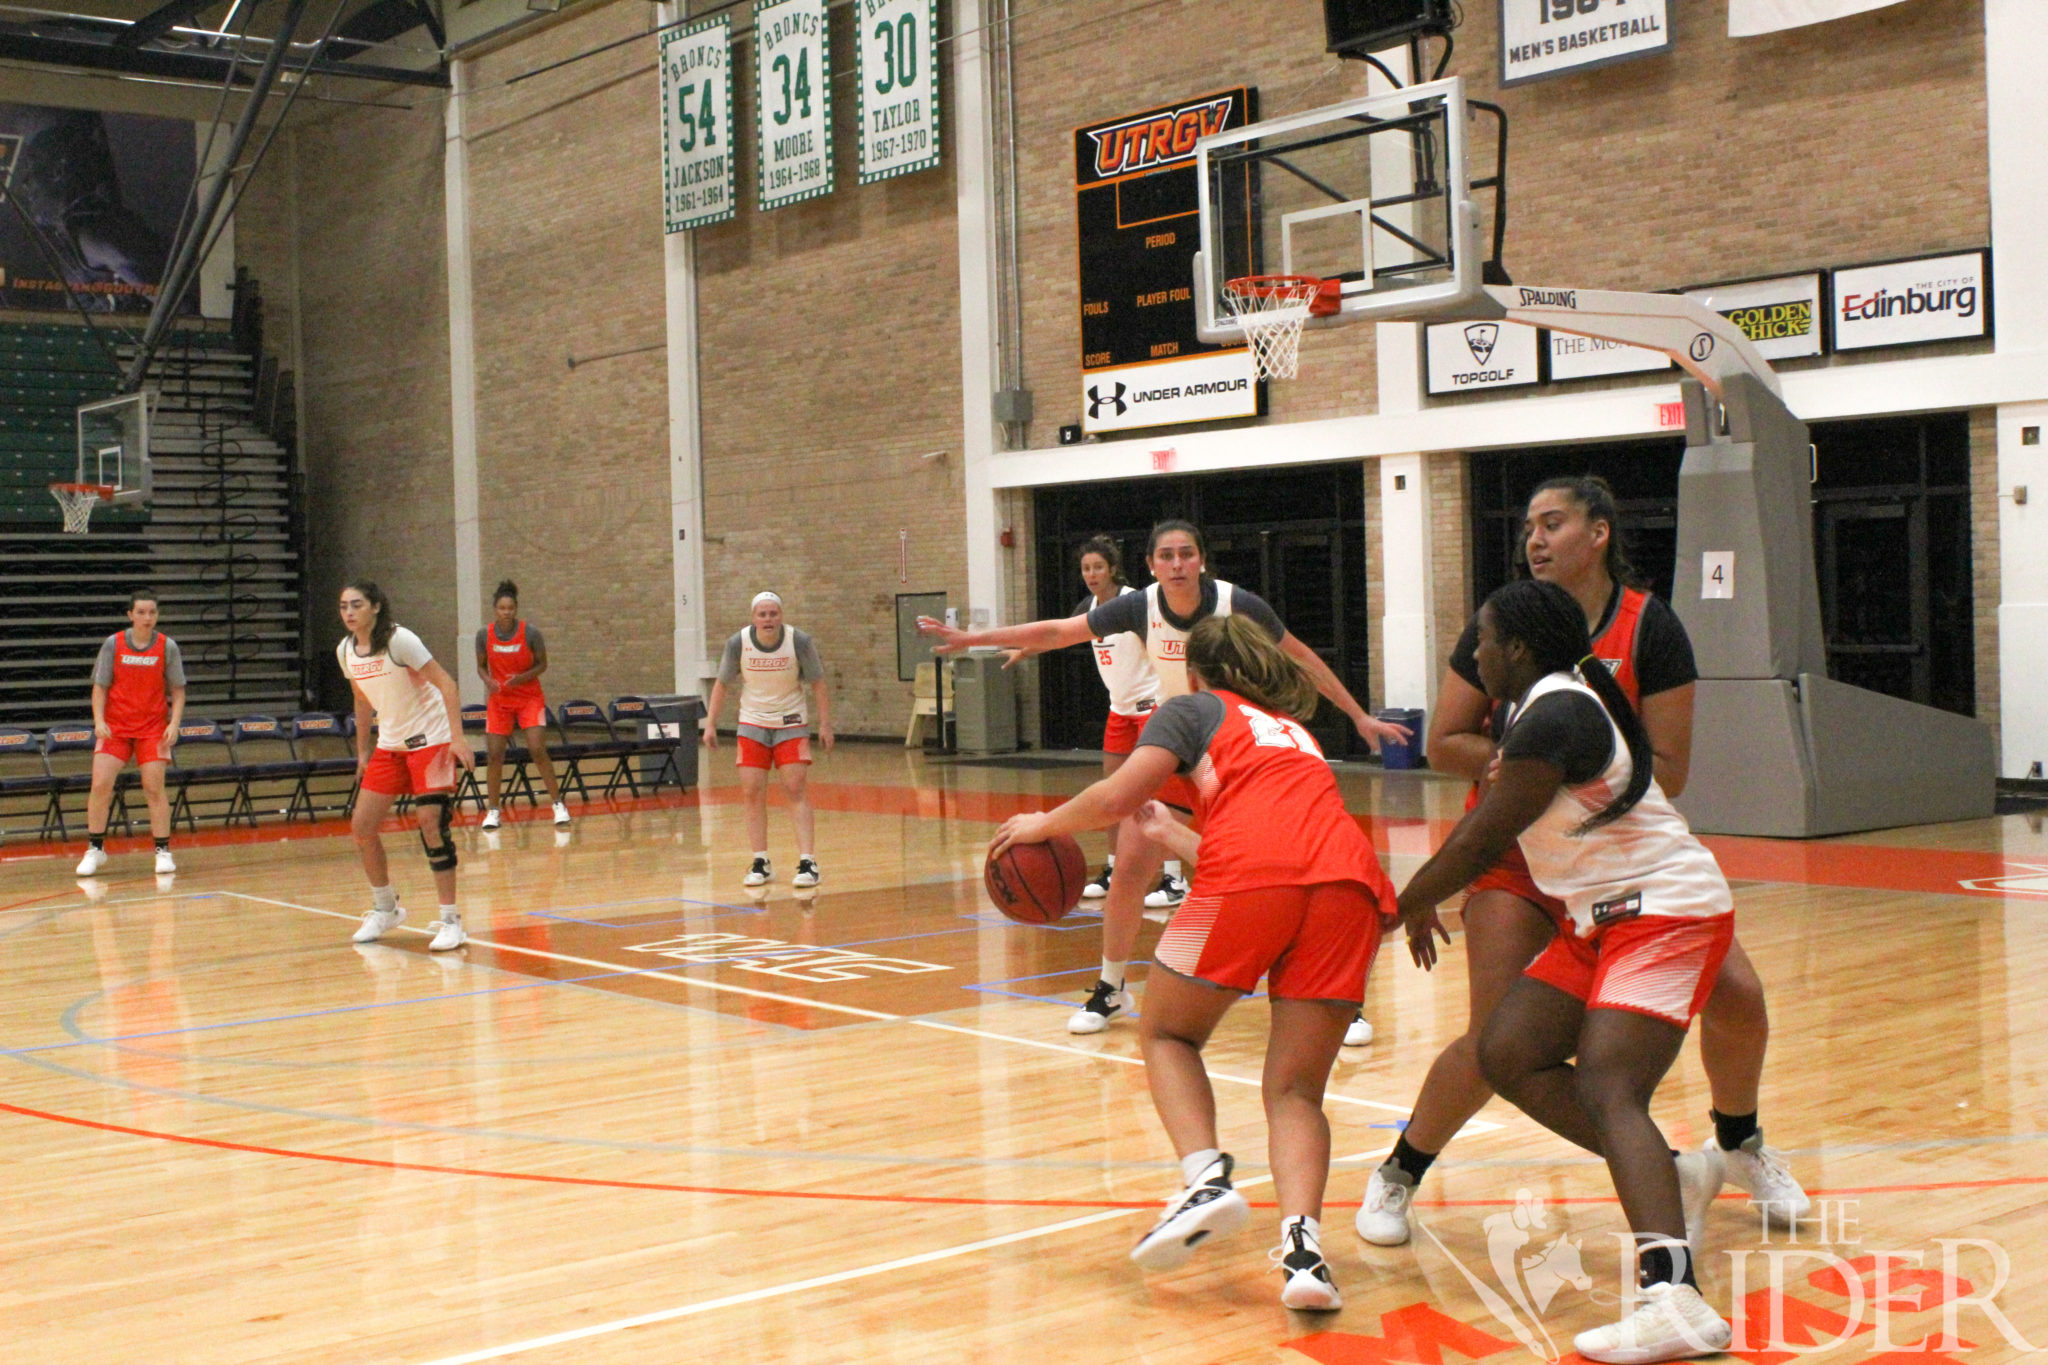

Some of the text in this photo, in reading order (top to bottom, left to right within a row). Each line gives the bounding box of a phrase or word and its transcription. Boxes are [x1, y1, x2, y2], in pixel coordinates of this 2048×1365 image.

[764, 12, 819, 51] BRONCS
[1510, 15, 1660, 64] MEN'S BASKETBALL
[671, 45, 722, 82] BRONCS
[874, 12, 917, 95] 30
[772, 47, 812, 125] 34
[678, 79, 716, 152] 54
[872, 98, 920, 133] TAYLOR
[774, 130, 814, 162] MOORE
[871, 129, 926, 162] 1967-1970
[1097, 100, 1229, 173] UTRGV
[673, 155, 724, 189] JACKSON
[769, 158, 821, 189] 1964-1968
[675, 184, 724, 213] 1961-1964
[1145, 232, 1176, 248] PERIOD
[1136, 287, 1191, 307] PLAYER FOUL
[1915, 276, 1975, 289] THE CITY OF
[1083, 301, 1109, 315] FOULS
[1520, 287, 1576, 309] SPALDING
[1841, 286, 1976, 321] Edinburg
[1729, 302, 1812, 328] GOLDEN
[1085, 352, 1111, 366] SCORE
[1150, 342, 1179, 357] MATCH
[1553, 338, 1587, 355] THE
[1133, 378, 1249, 404] UNDER ARMOUR
[1452, 368, 1514, 385] TOPGOLF
[1711, 564, 1724, 584] 4
[1098, 649, 1113, 666] 25
